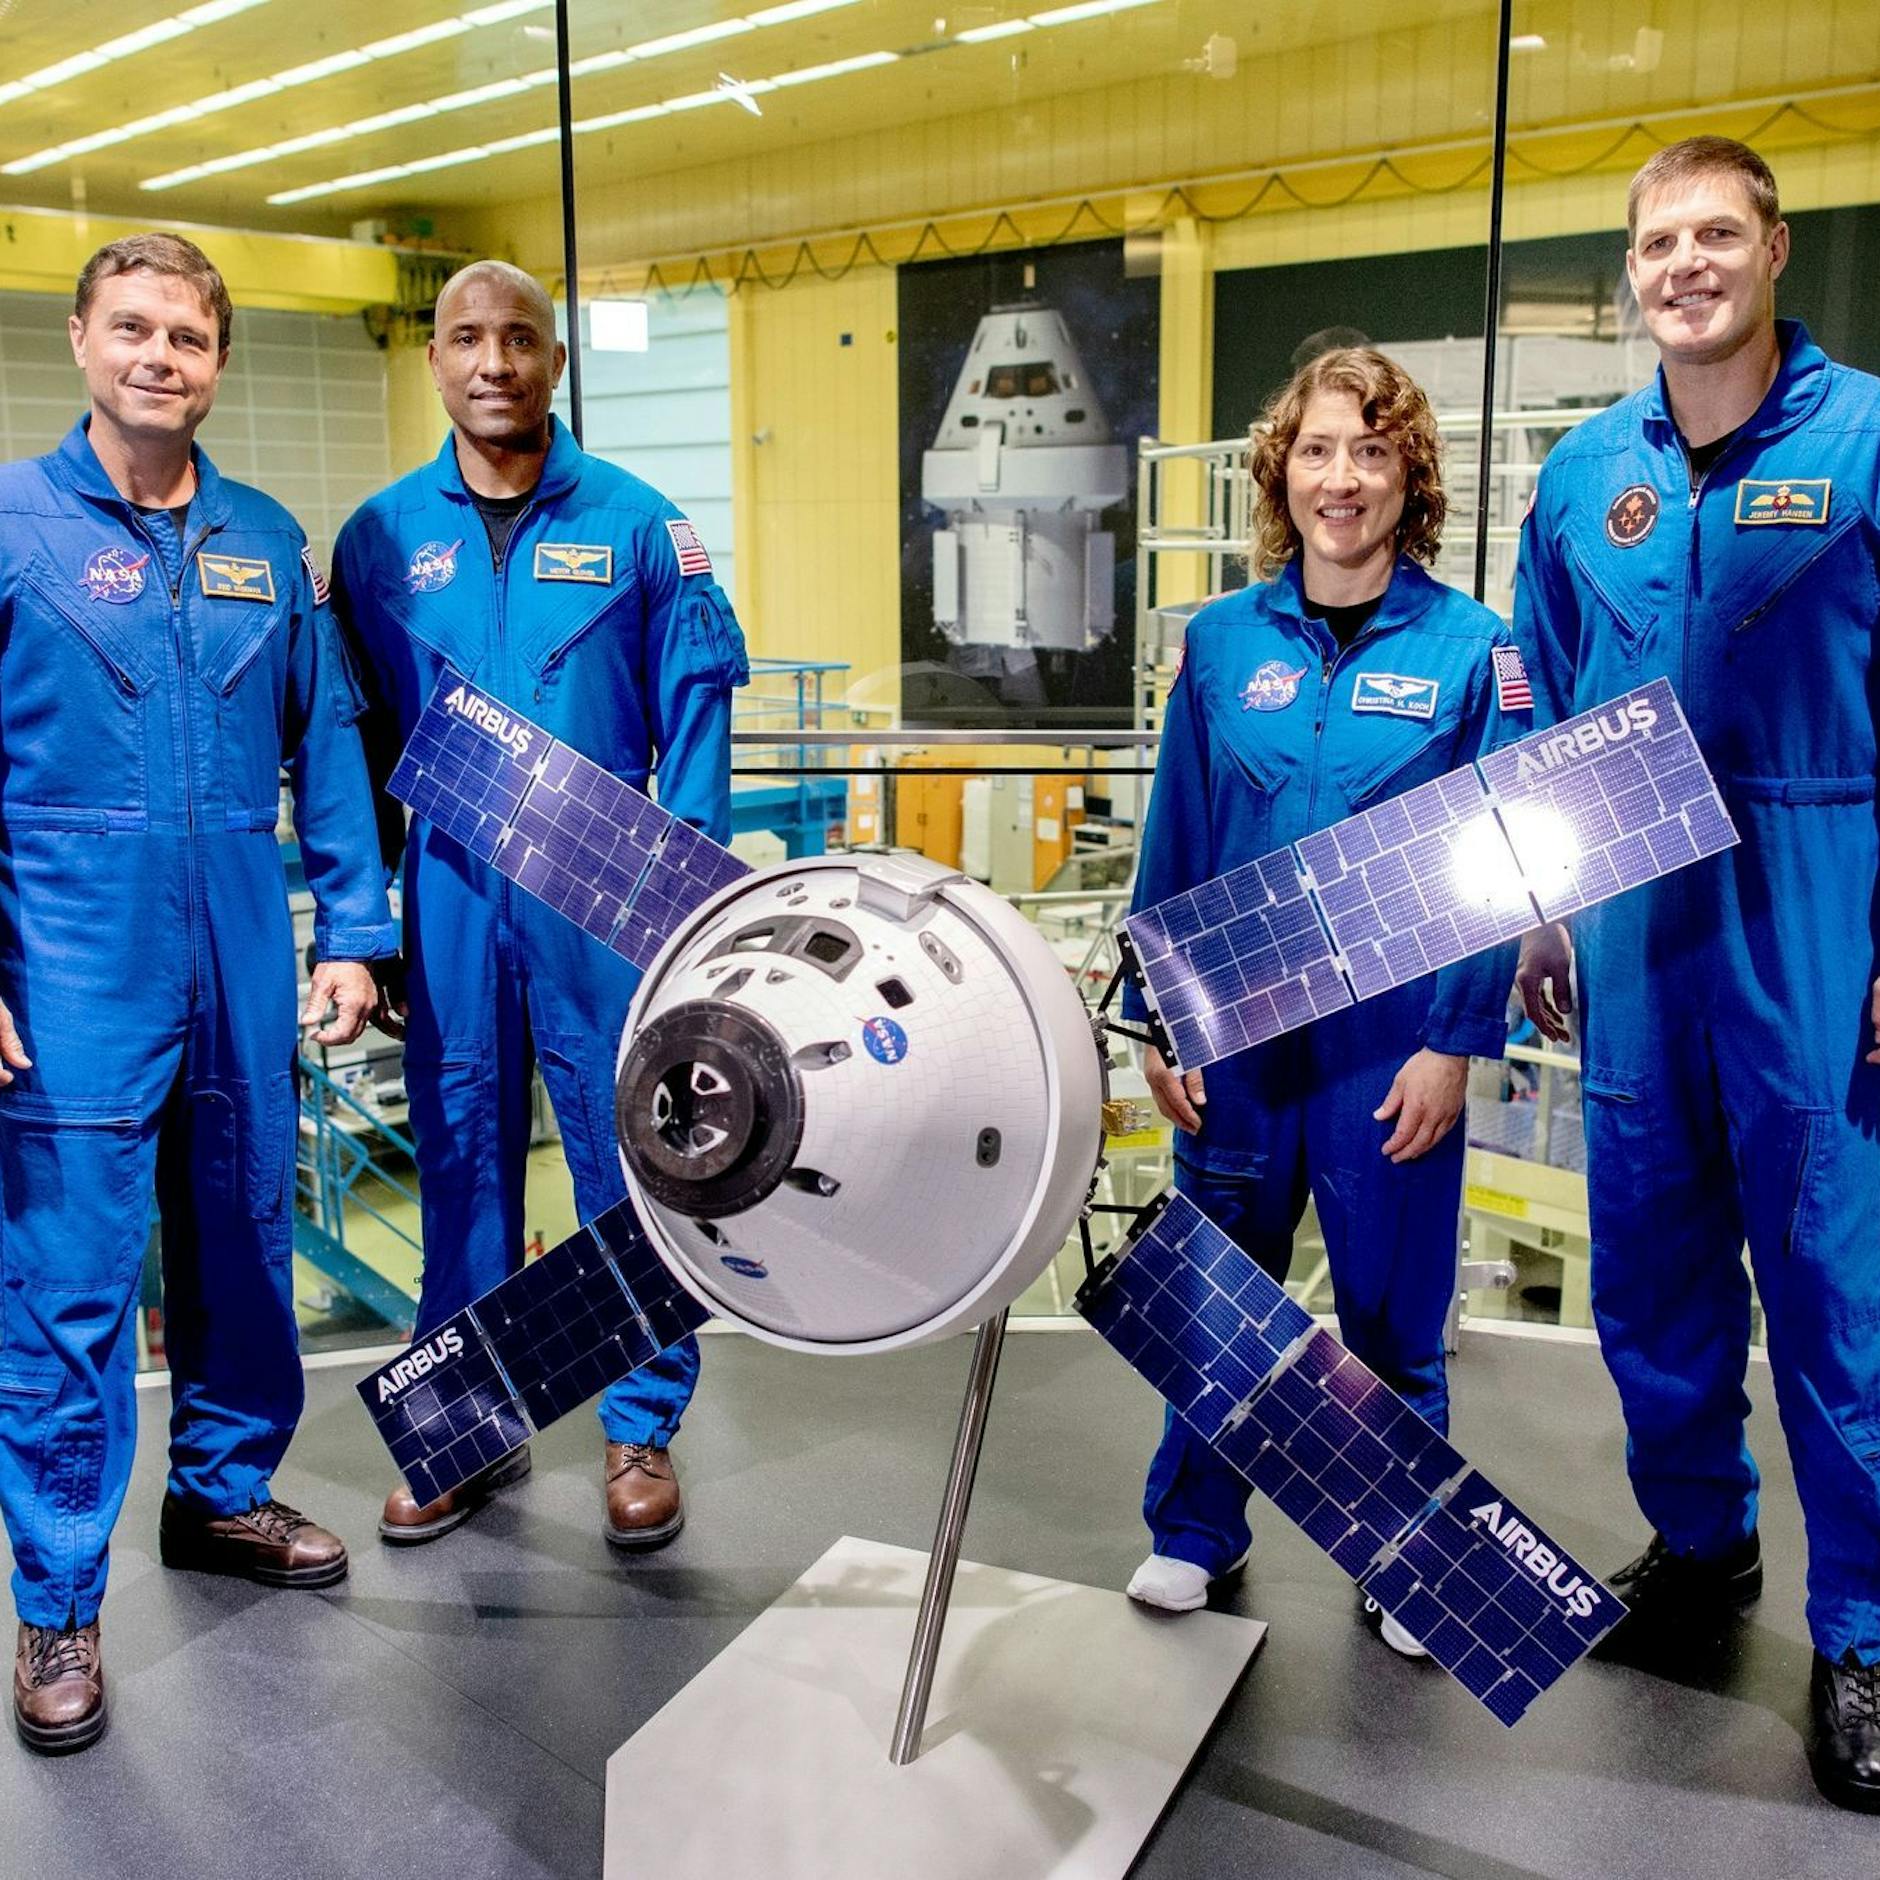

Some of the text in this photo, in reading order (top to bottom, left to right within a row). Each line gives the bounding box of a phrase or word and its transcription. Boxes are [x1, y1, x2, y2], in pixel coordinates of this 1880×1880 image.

[1749, 509, 1813, 519] JEREMY HANSEN
[89, 567, 142, 582] NASA
[411, 558, 454, 577] NASA
[1248, 680, 1296, 693] NASA
[444, 686, 534, 754] AIRBUS
[1517, 698, 1657, 779] AIRBUS
[873, 1018, 899, 1062] NASA
[377, 1327, 464, 1403] AIRBUS
[1469, 1501, 1601, 1617] AIRBUS
